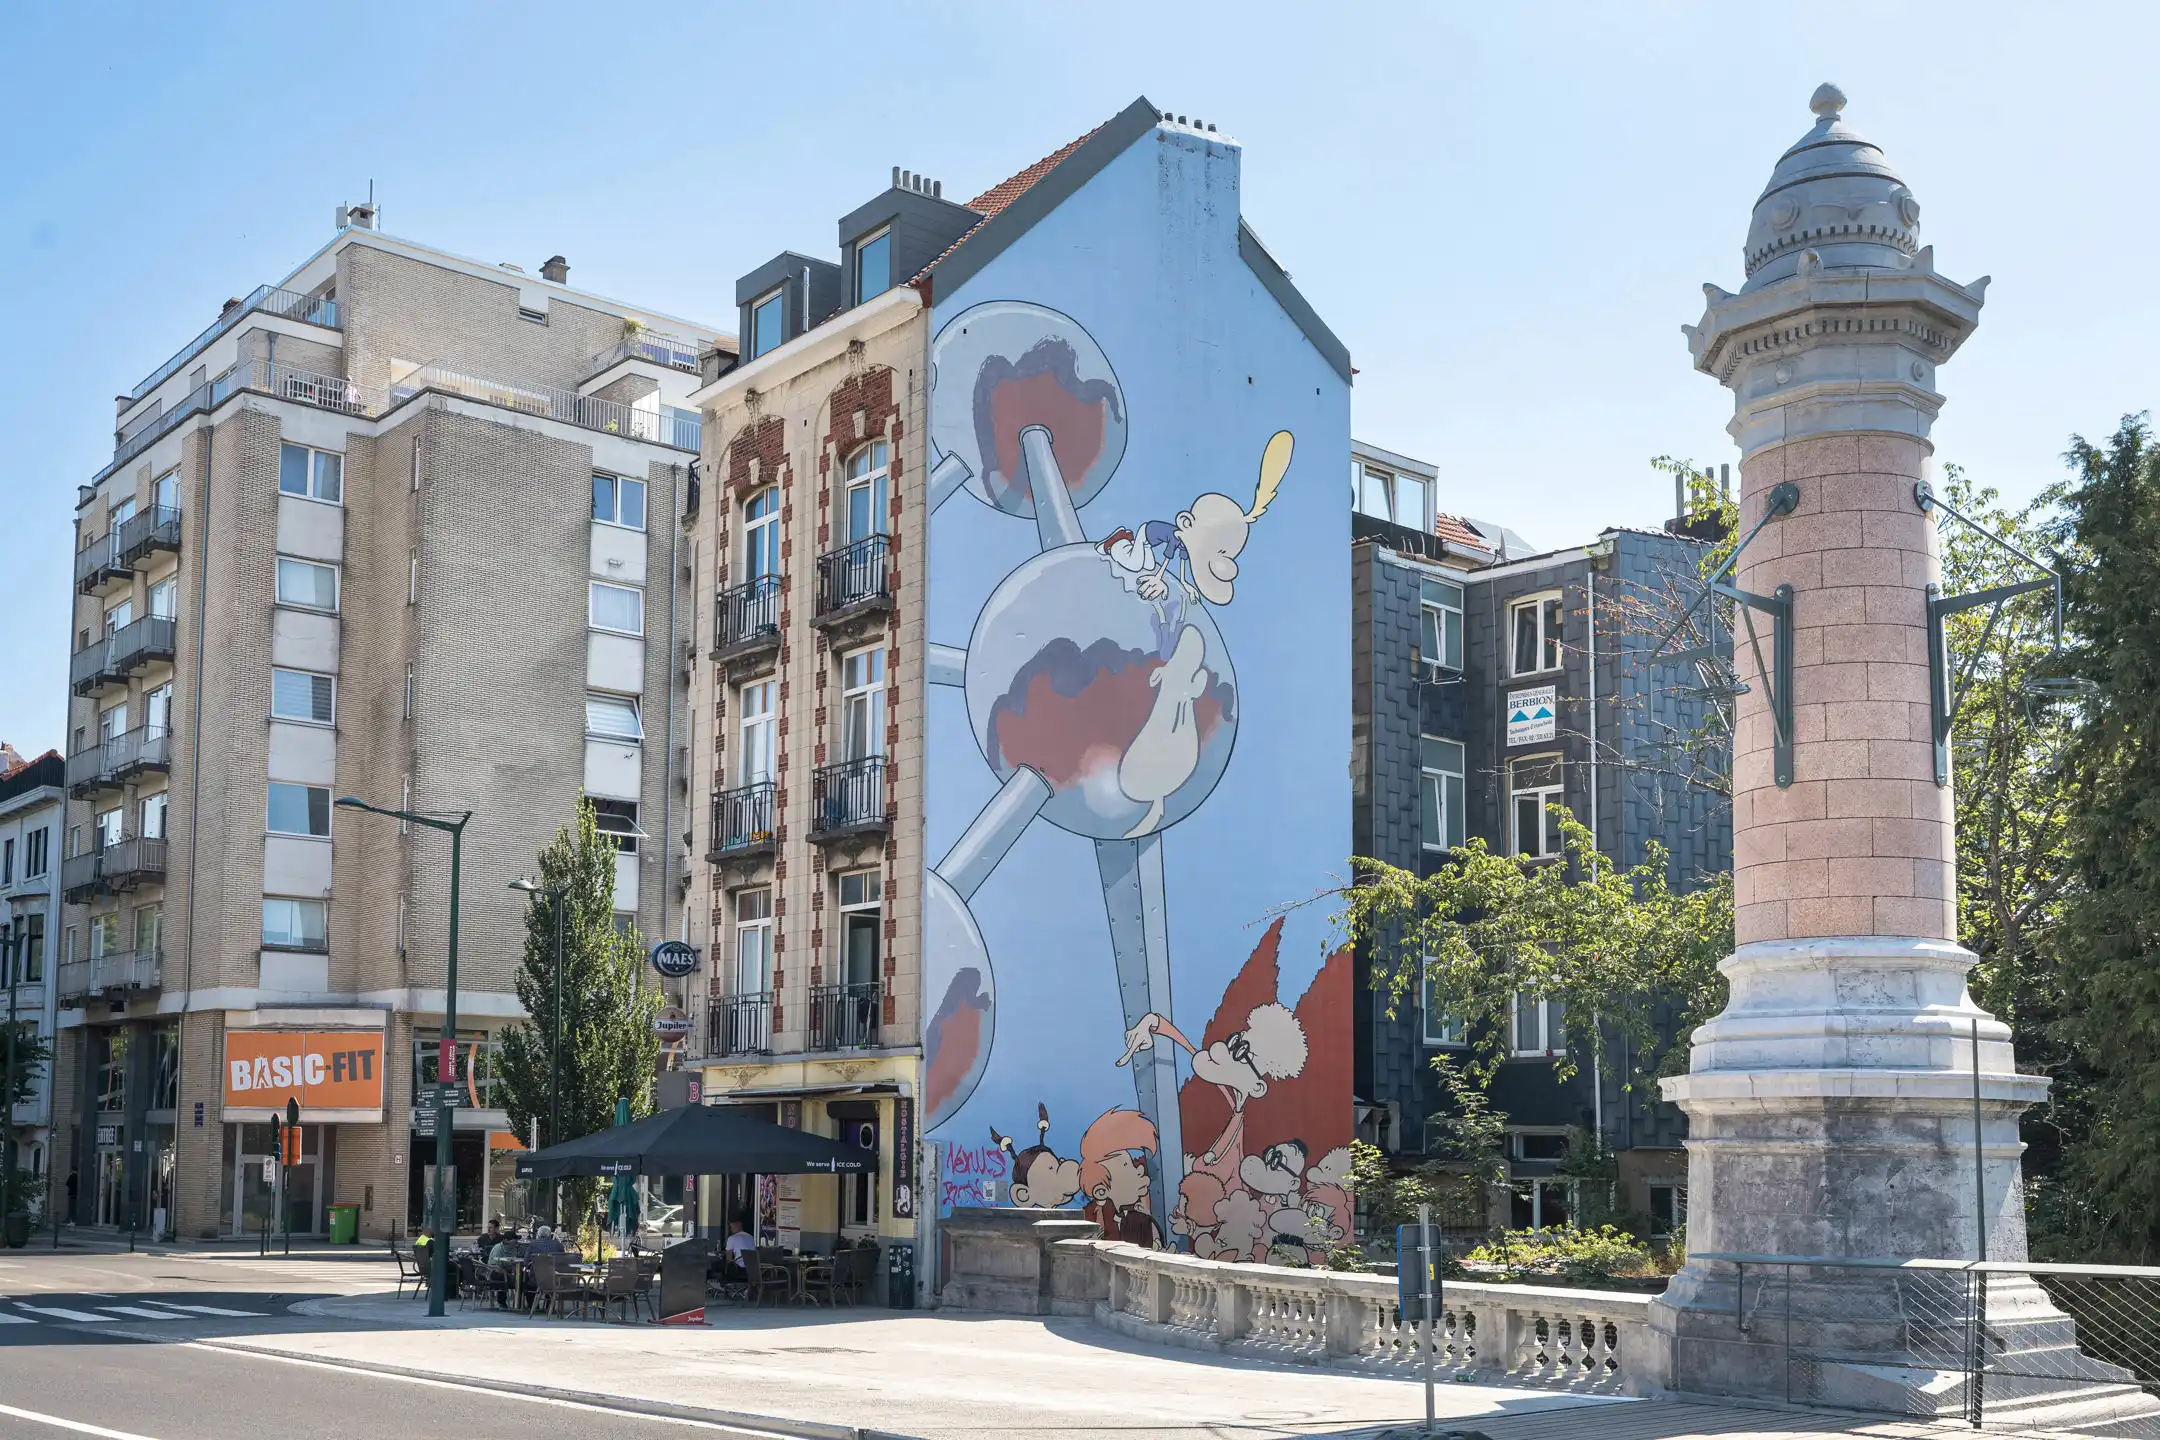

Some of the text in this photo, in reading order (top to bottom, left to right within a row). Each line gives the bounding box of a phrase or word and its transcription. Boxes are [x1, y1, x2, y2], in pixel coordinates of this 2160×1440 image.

[660, 952, 694, 965] MAES
[657, 1021, 687, 1030] Jupiler
[230, 1049, 375, 1091] BASIC-FIT
